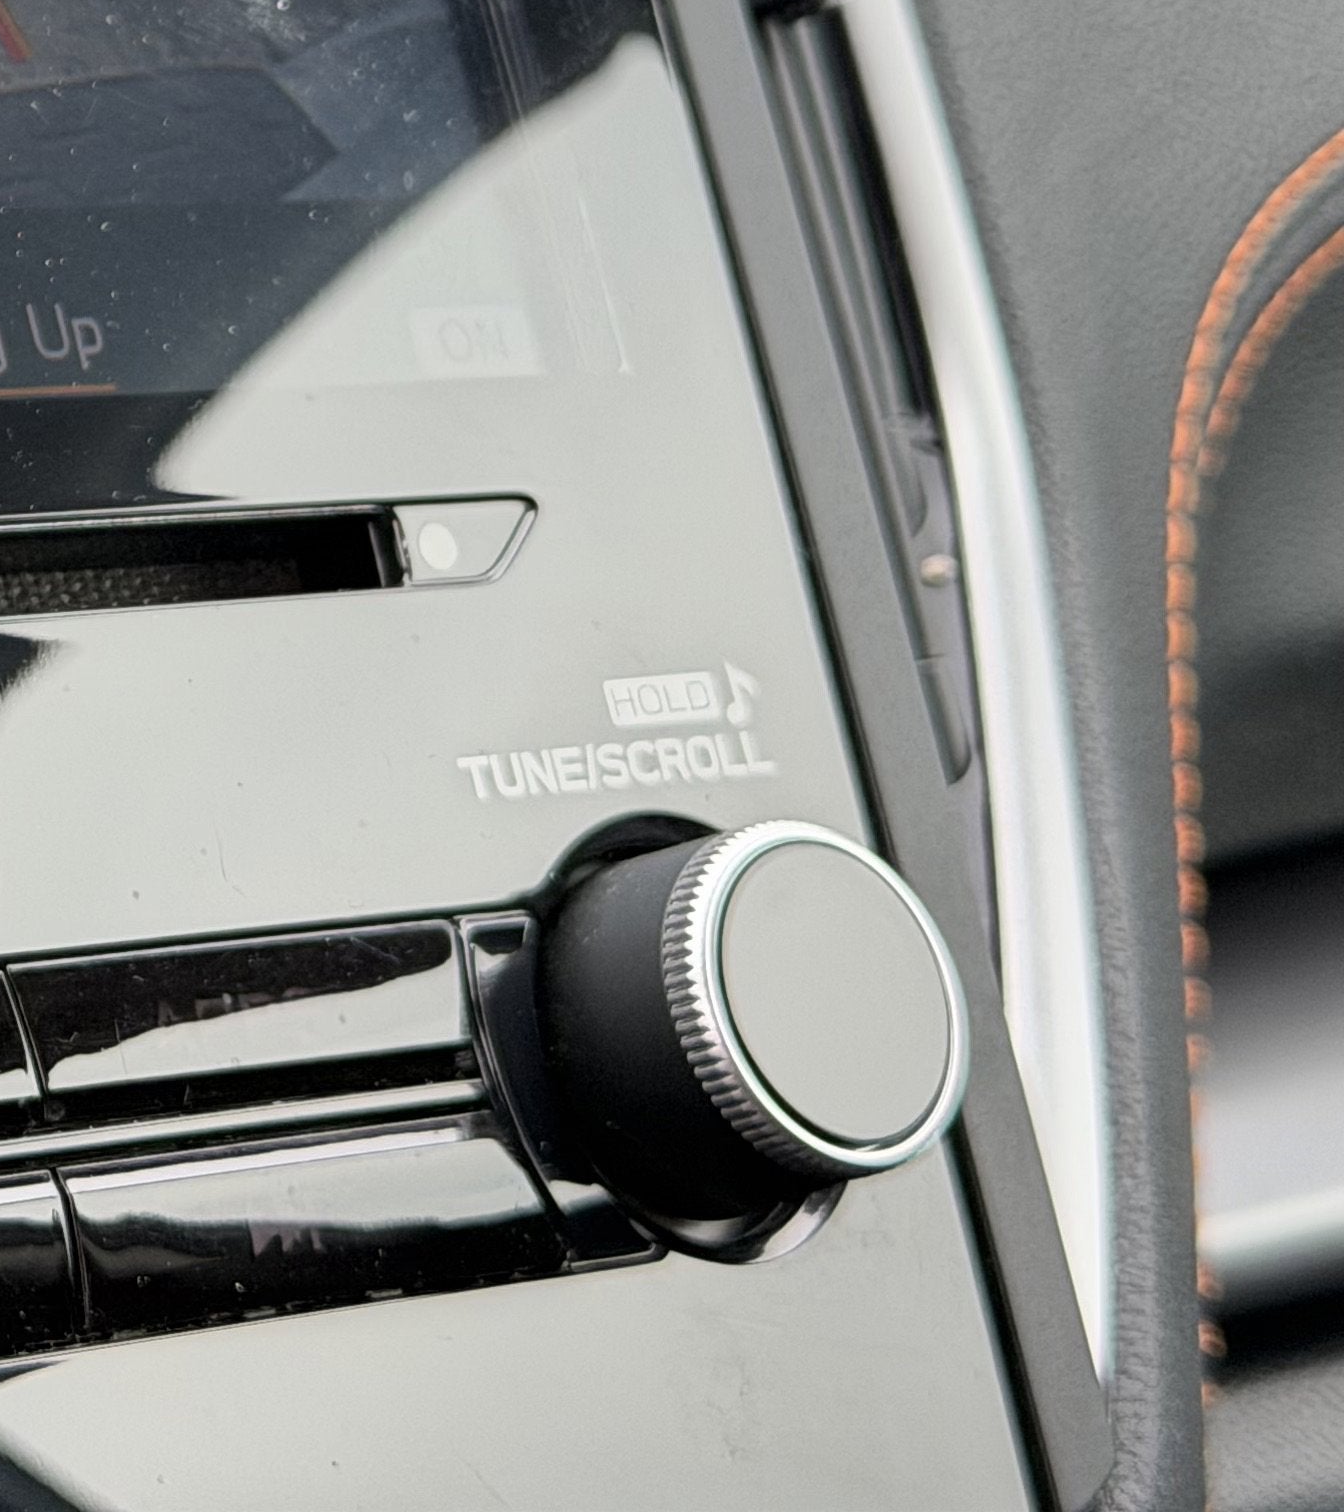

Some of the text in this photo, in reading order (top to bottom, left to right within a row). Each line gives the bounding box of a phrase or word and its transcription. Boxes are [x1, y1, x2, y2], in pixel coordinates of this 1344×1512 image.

[25, 302, 104, 371] Up
[611, 679, 713, 718] HOLD
[456, 730, 776, 800] TUNE/SCROLL
